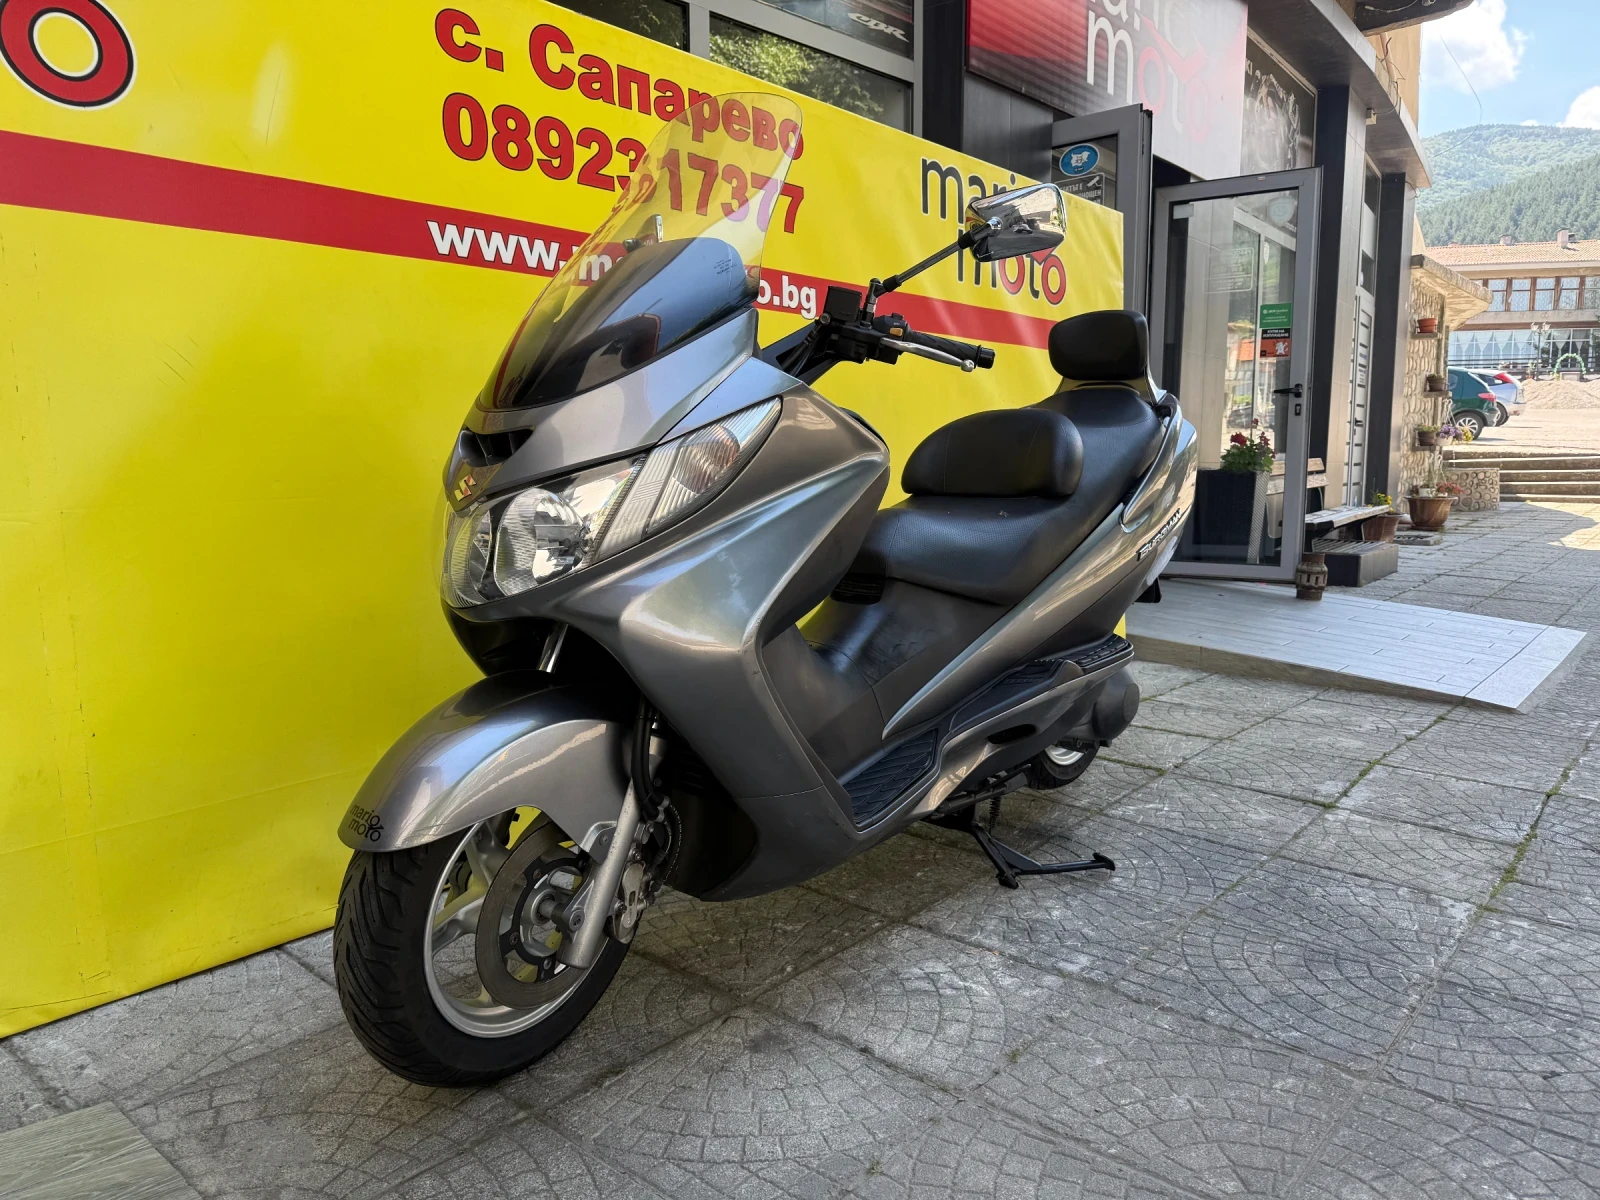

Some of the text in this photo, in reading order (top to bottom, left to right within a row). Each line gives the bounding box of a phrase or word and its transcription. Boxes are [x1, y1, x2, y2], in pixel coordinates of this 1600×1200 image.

[529, 23, 804, 161] Сапарево
[349, 804, 380, 827] mario
[347, 817, 382, 842] moto
